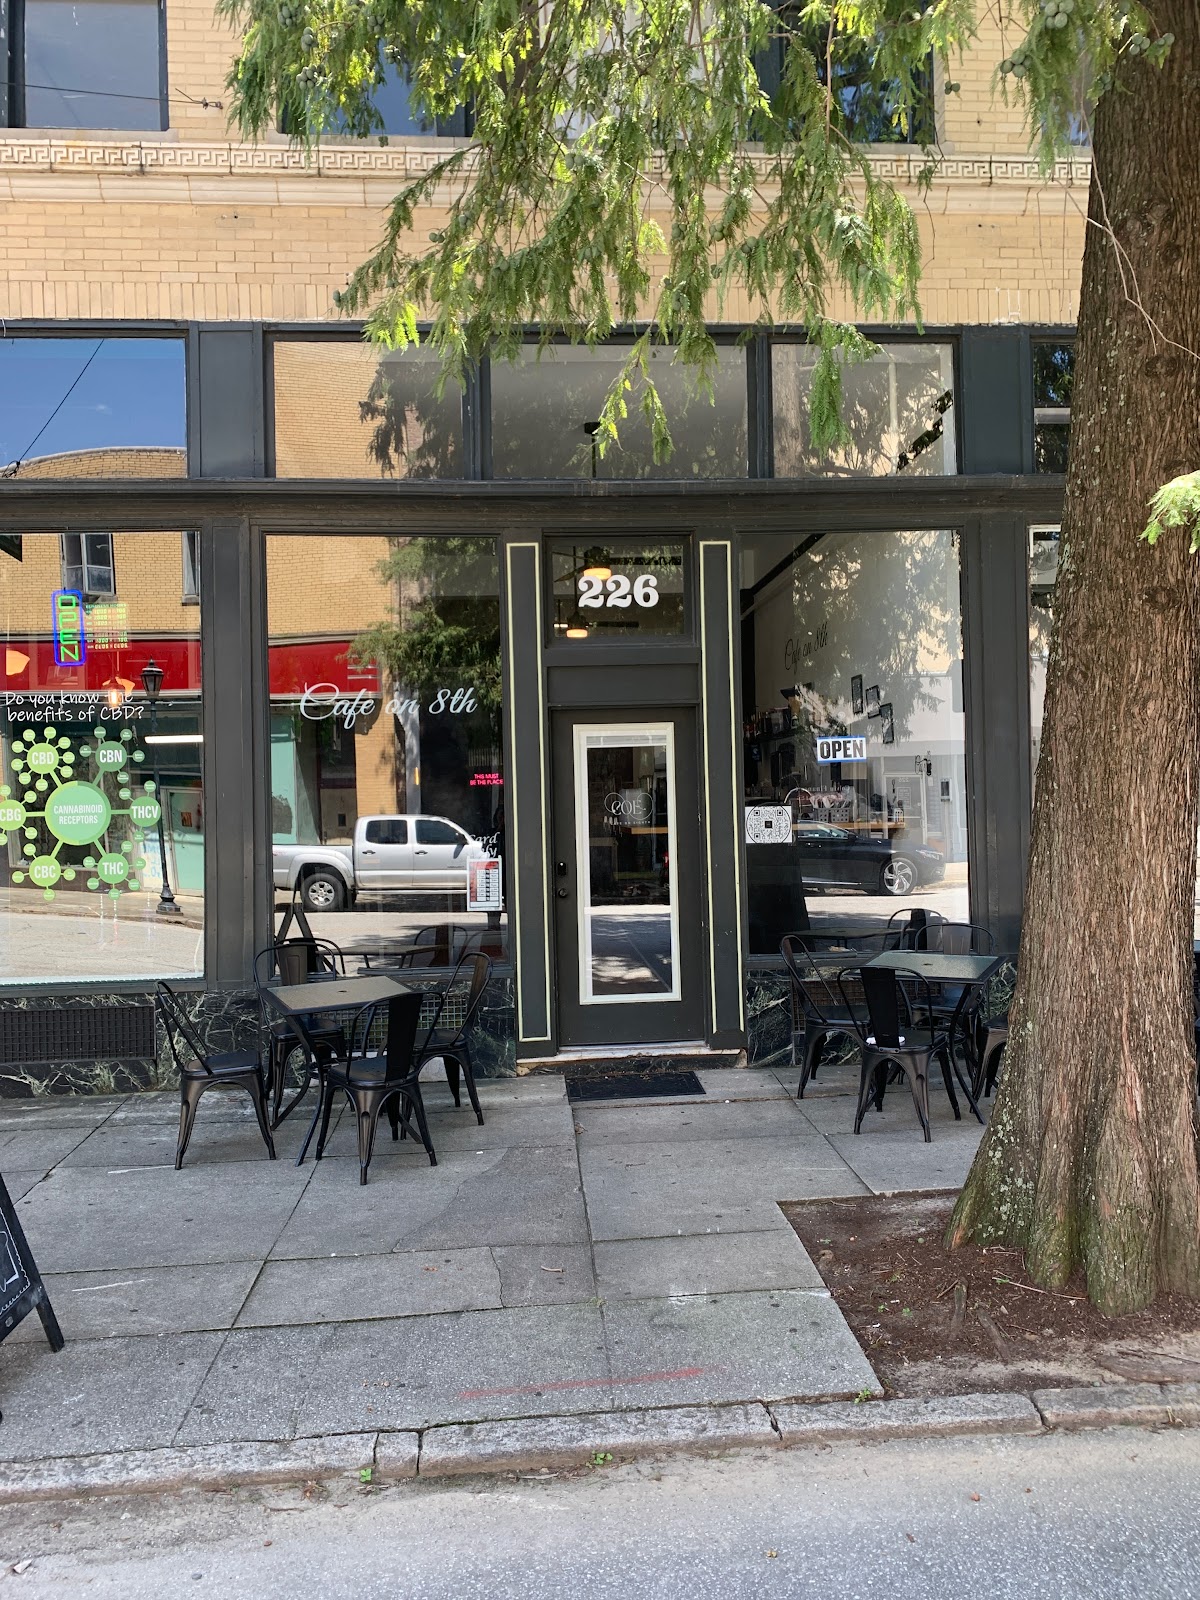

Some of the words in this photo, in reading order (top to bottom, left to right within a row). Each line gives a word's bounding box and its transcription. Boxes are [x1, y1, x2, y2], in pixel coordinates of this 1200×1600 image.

[577, 574, 660, 608] 226
[57, 595, 79, 662] OPEN
[2, 691, 24, 706] Do
[29, 692, 56, 708] you
[60, 690, 99, 705] know
[300, 682, 376, 730] Cafe
[384, 697, 421, 715] on
[428, 687, 478, 715] 8th
[7, 706, 73, 723] benefits
[78, 705, 95, 722] of
[100, 705, 145, 720] CBD?
[99, 749, 123, 763] CBN
[820, 739, 864, 760] OPEN
[31, 751, 55, 765] CBD
[0, 808, 22, 822] CBG
[53, 804, 103, 814] CANNABINOID
[131, 805, 159, 819] THCV
[58, 815, 98, 825] RECEPTORS
[34, 867, 56, 879] CBC
[102, 862, 124, 875] THC
